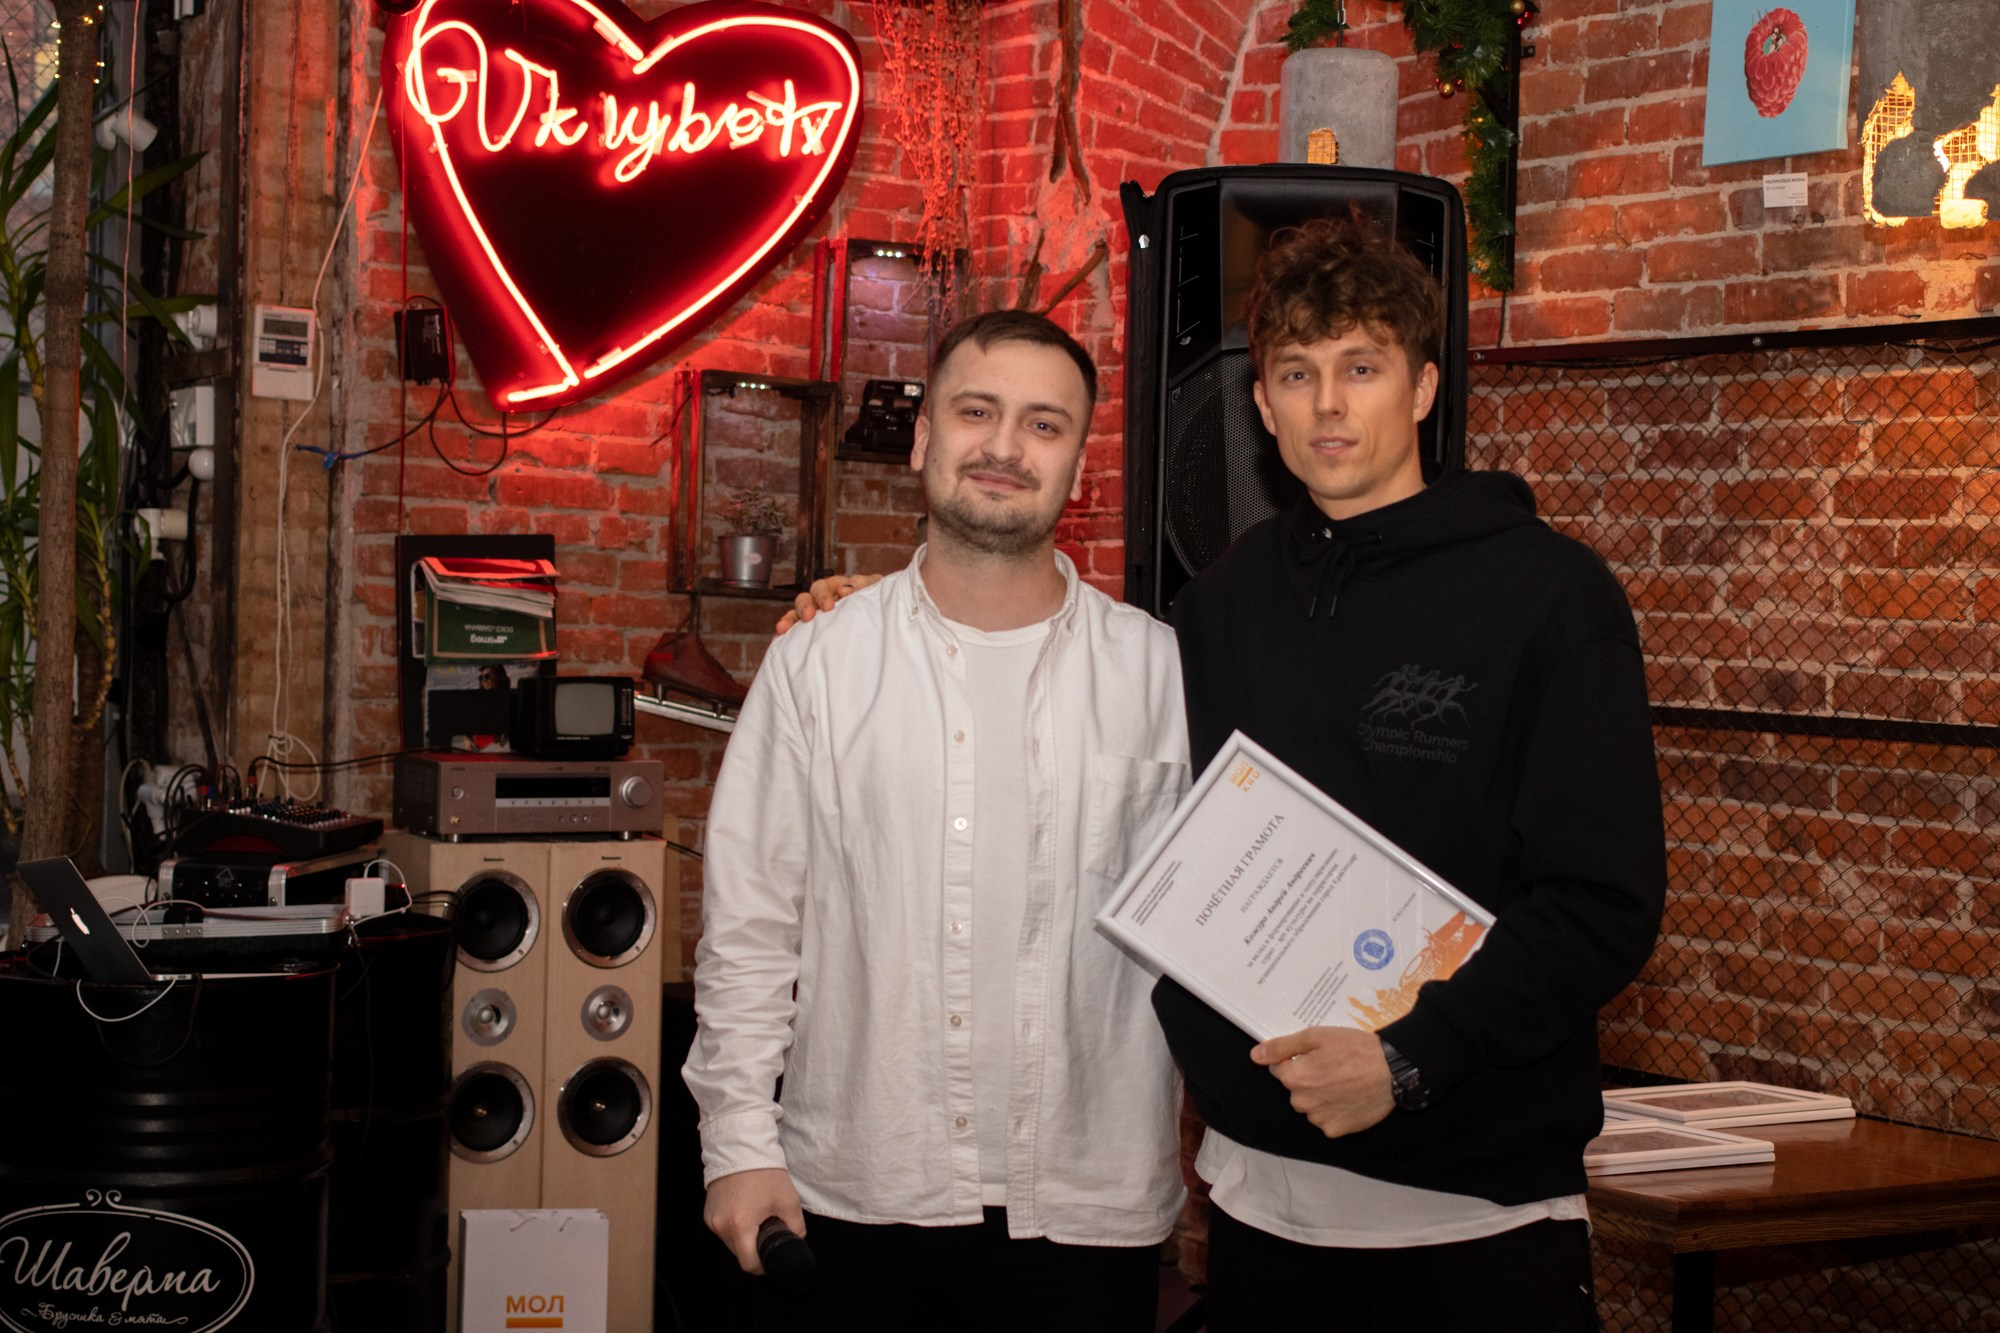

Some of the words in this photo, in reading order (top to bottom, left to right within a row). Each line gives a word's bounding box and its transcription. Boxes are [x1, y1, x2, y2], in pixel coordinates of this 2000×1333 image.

[1357, 721, 1410, 741] Olympic
[1412, 730, 1469, 751] Runners
[1362, 738, 1458, 765] Championship
[1194, 864, 1244, 925] ПОЧЁТНАЯ
[1240, 812, 1284, 866] ГРАМОТА
[1239, 857, 1283, 912] НАГРАЖДАЕТСЯ
[0, 1231, 221, 1312] Шаверма
[37, 1301, 105, 1329] Брусника
[108, 1311, 123, 1326] &
[124, 1312, 168, 1325] мята
[506, 1295, 564, 1314] МОЛ
